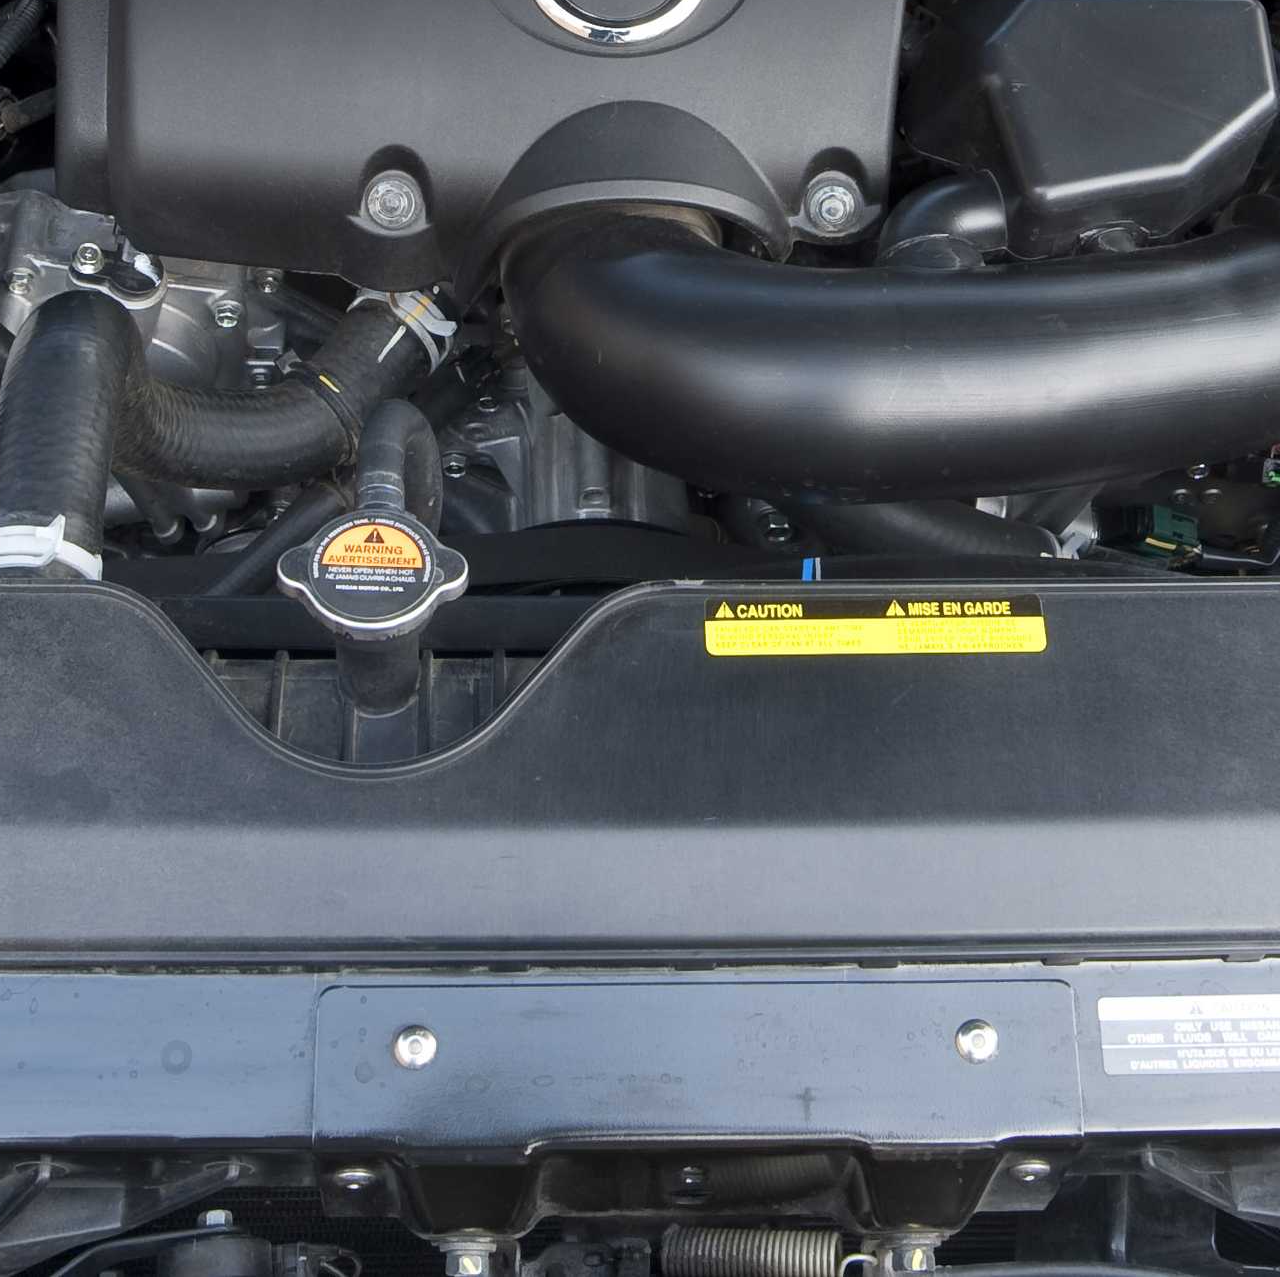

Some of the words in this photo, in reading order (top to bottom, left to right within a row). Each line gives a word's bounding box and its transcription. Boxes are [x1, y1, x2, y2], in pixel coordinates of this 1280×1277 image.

[344, 544, 403, 555] WARNING
[328, 555, 417, 566] AVERTISSEMENT
[328, 566, 352, 574] NEVER
[737, 604, 803, 618] CAUTION
[908, 602, 939, 615] MISE
[943, 602, 961, 615] EN
[964, 602, 1011, 615] GARDE
[1174, 1022, 1202, 1032] ONLY
[1128, 1033, 1164, 1044] OTHER
[1174, 1032, 1212, 1043] FLUIDS
[1222, 1032, 1248, 1042] WILL
[1183, 1059, 1228, 1069] LIQUIDES
